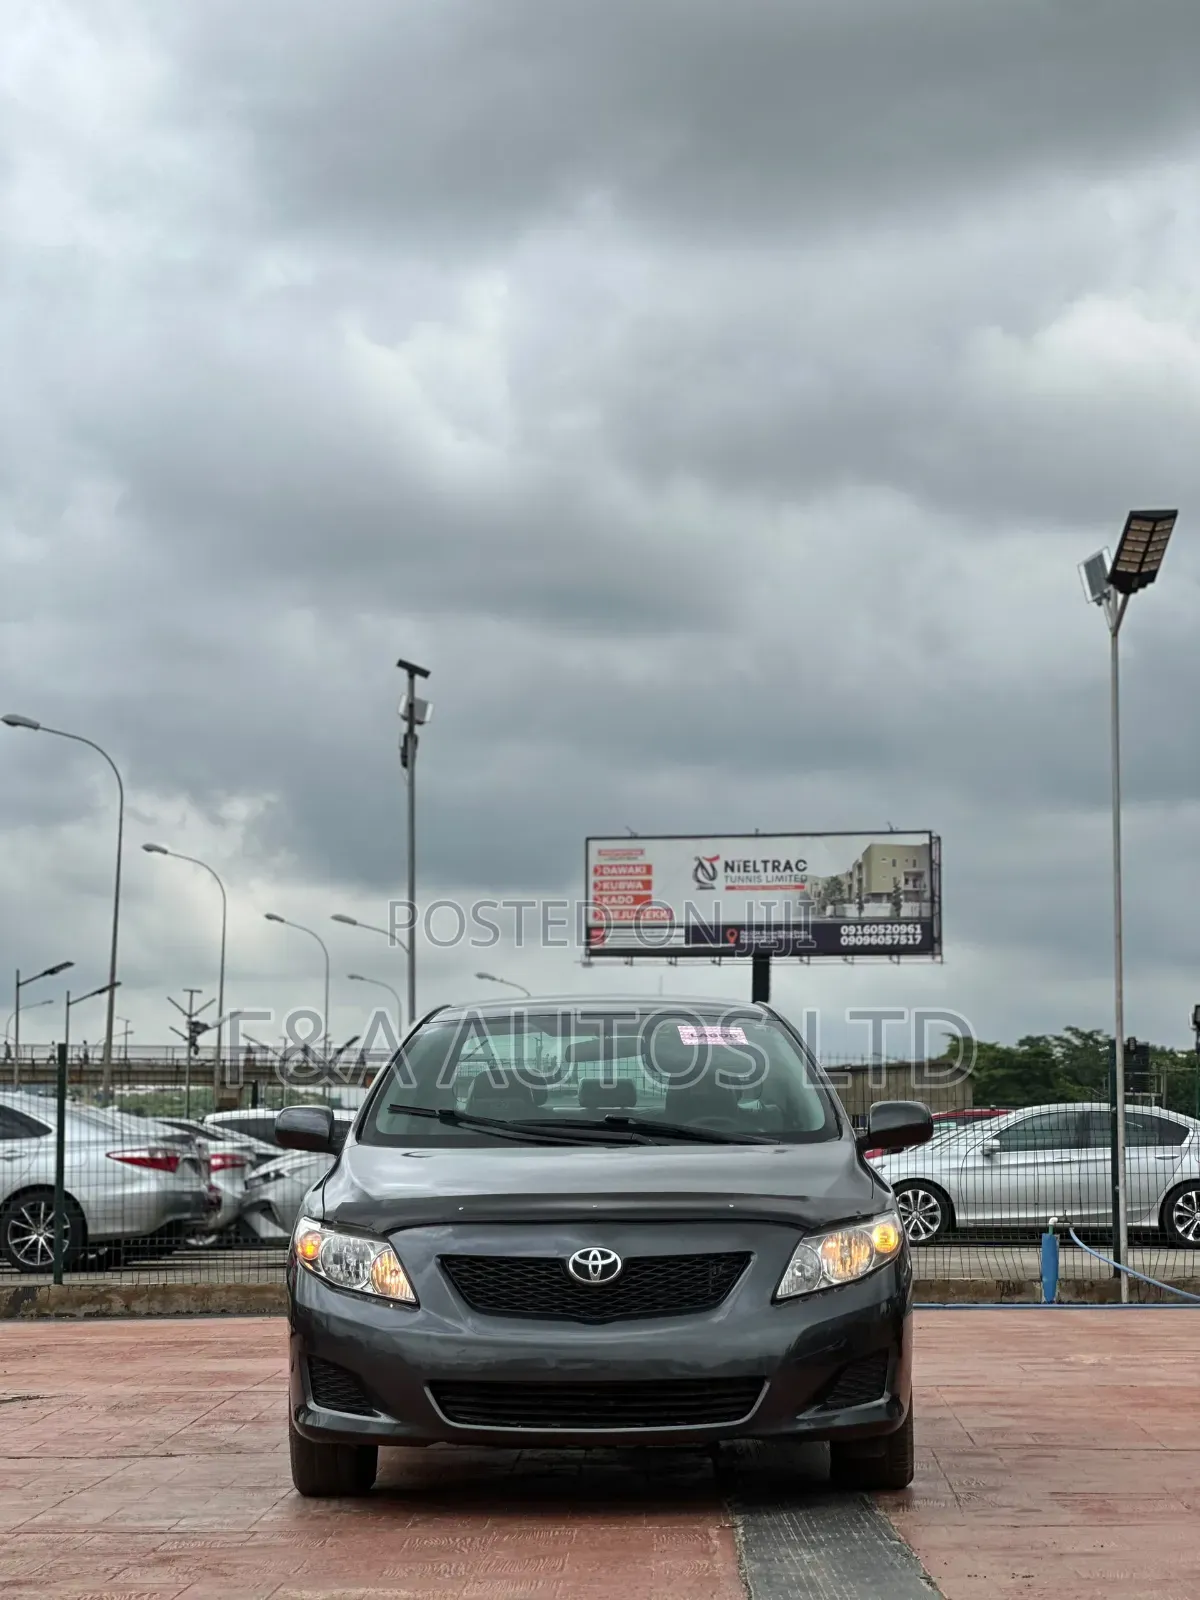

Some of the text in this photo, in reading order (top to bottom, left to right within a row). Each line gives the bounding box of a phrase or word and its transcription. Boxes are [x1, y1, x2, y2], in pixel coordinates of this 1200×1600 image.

[602, 866, 647, 875] DAWAKI
[724, 874, 808, 883] TUNNIS LIMITED
[602, 881, 643, 890] KUBWA
[602, 896, 634, 905] KADO
[840, 924, 922, 935] 09160520961
[840, 934, 922, 946] 09096057517
